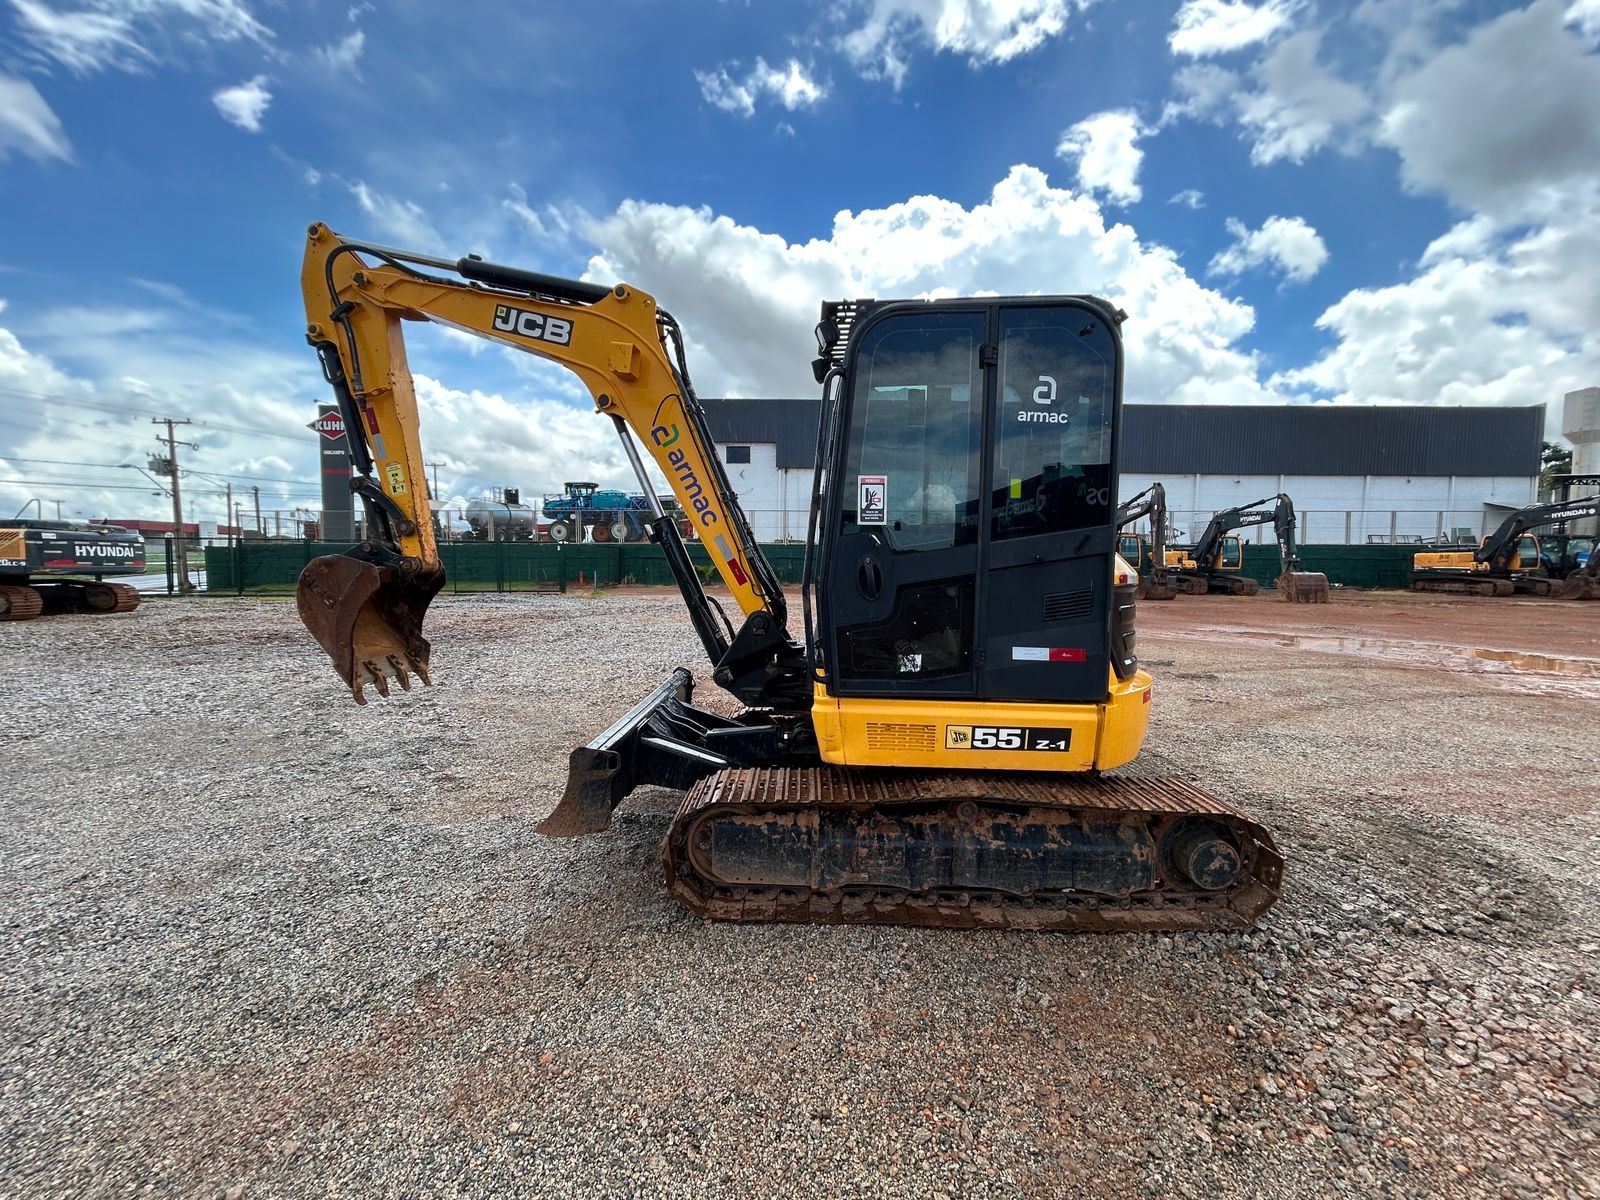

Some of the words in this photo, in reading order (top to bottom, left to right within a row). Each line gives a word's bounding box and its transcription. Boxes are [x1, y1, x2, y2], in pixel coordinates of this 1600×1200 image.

[494, 308, 571, 344] JCB
[1017, 410, 1069, 424] armac
[667, 447, 718, 527] armac
[1551, 508, 1588, 519] HYUNDAI
[74, 545, 135, 558] HYUNDAI
[952, 730, 969, 744] JCB
[972, 727, 1021, 749] 55
[1035, 739, 1066, 750] Z-1
